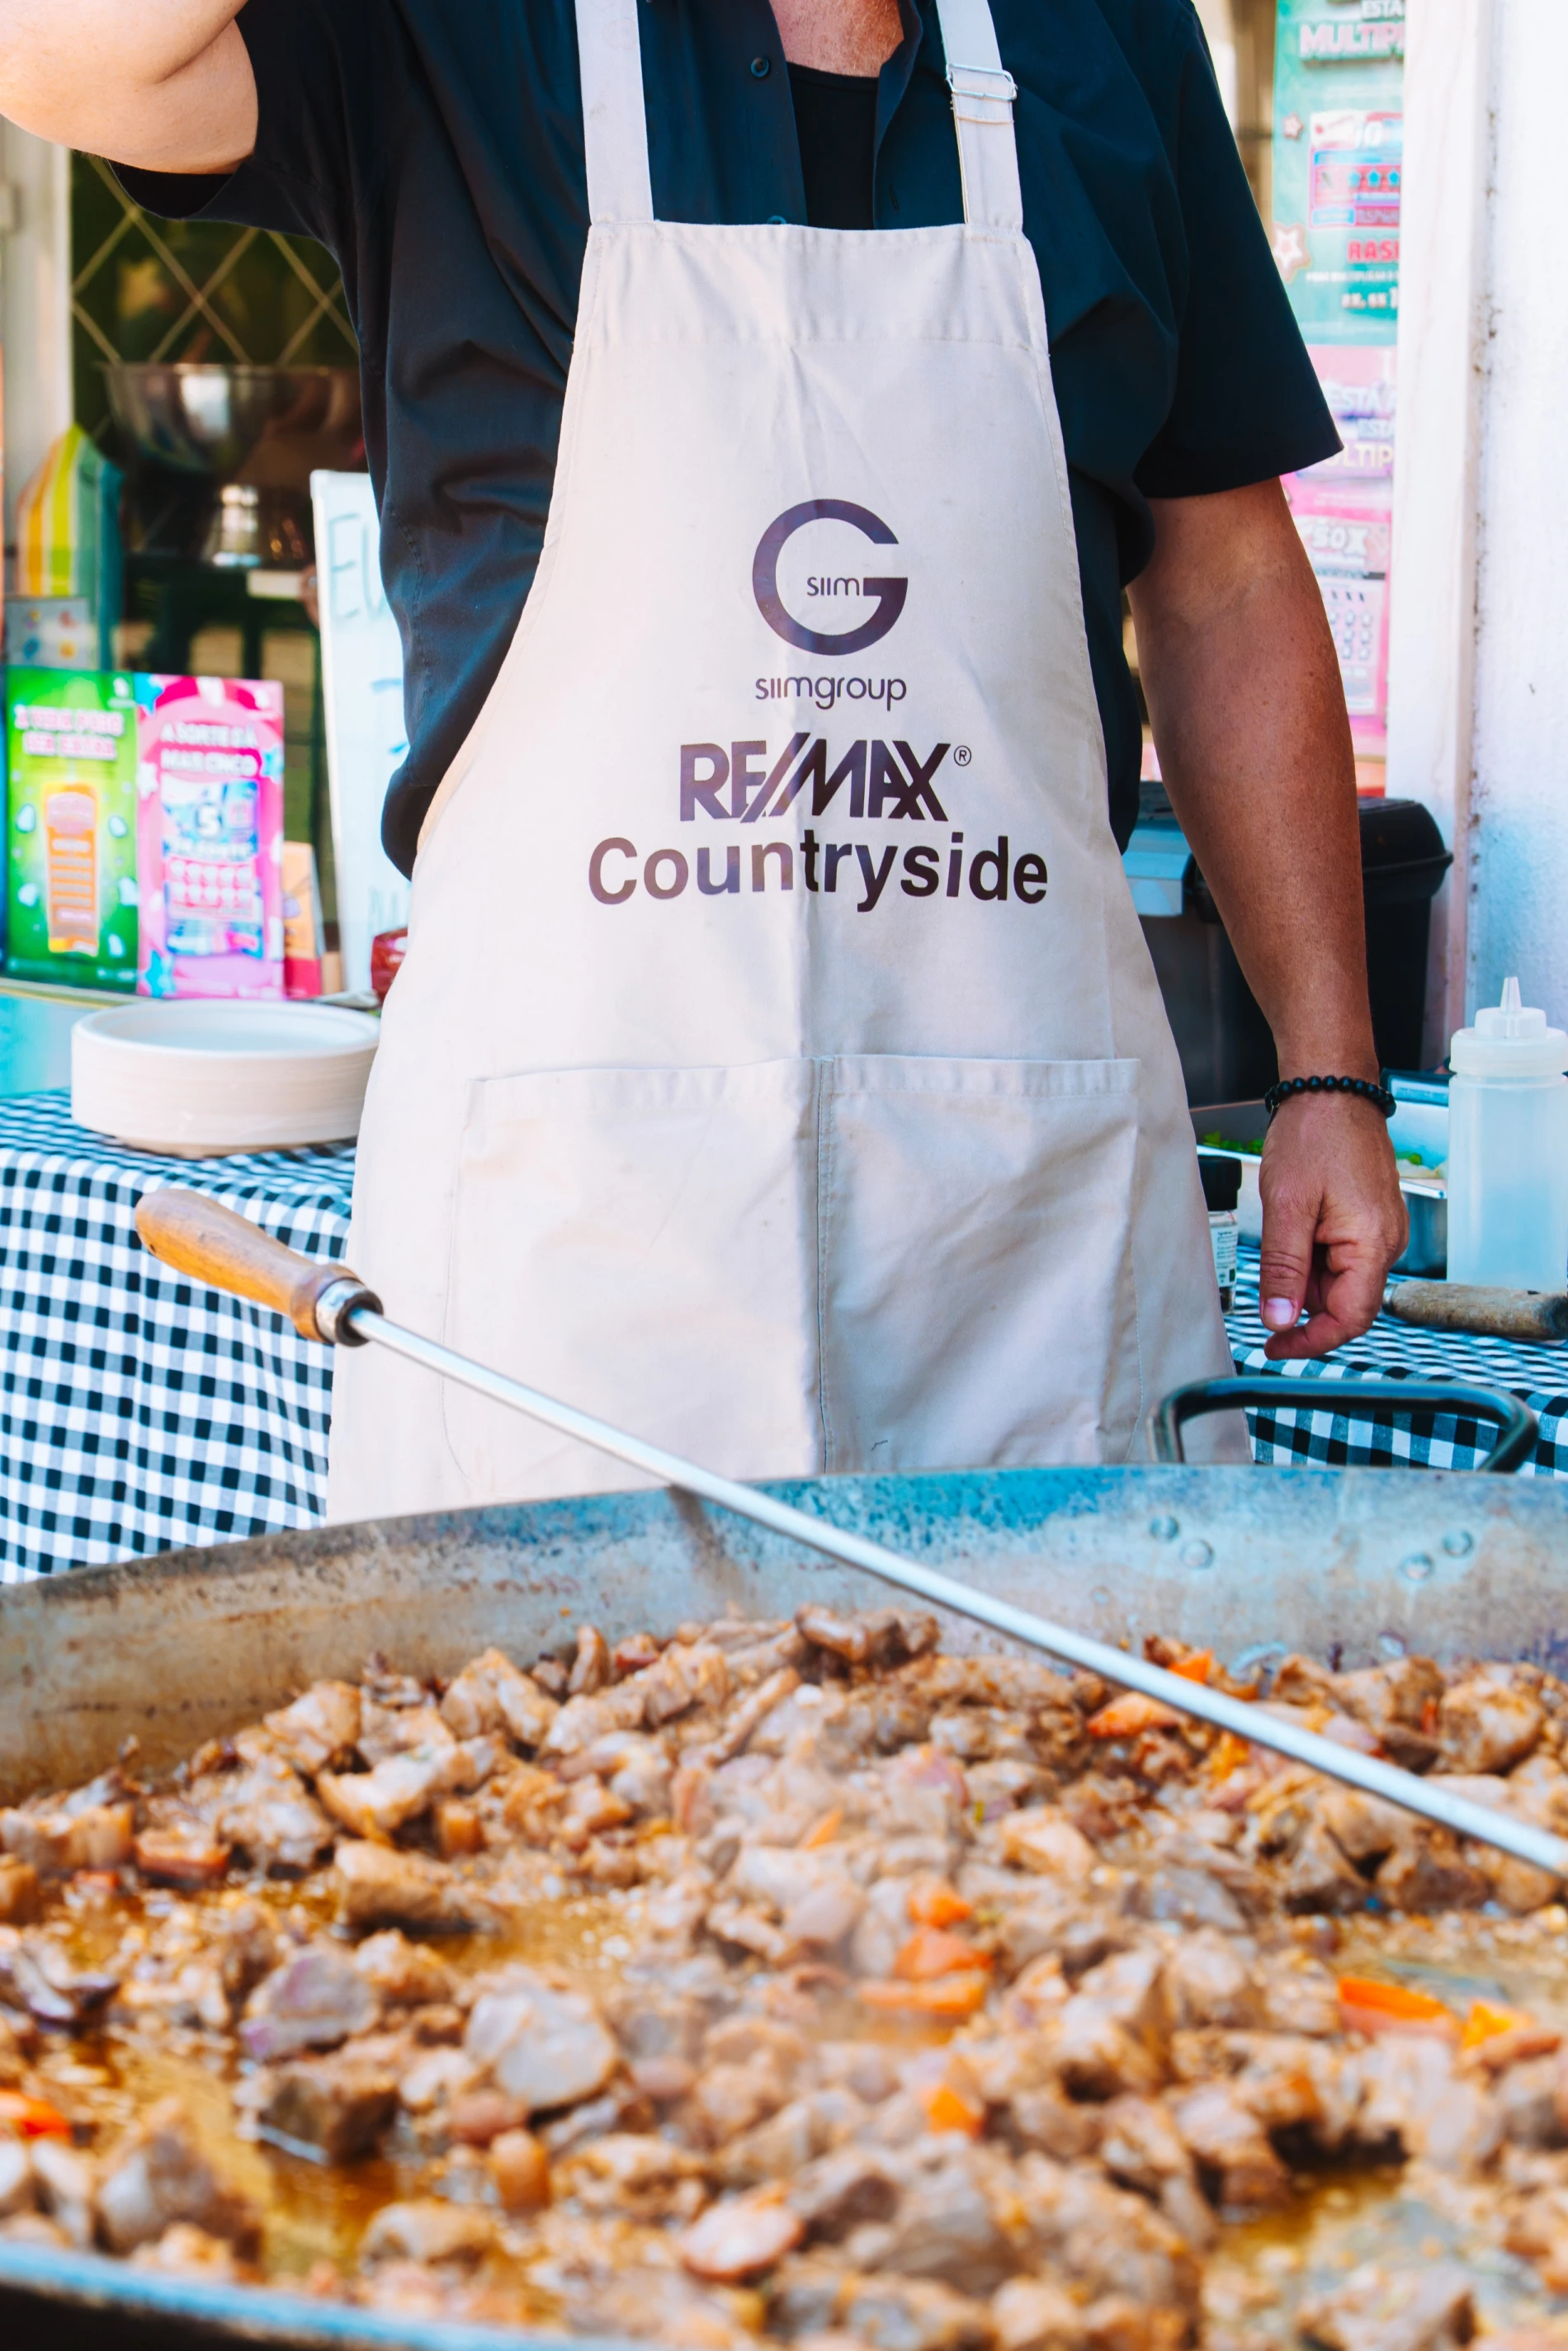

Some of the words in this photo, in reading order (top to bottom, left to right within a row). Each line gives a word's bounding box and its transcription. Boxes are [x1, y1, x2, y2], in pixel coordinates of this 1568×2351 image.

[806, 576, 860, 597] siim
[754, 675, 907, 711] siimgroup
[588, 829, 1048, 913] Countryside
